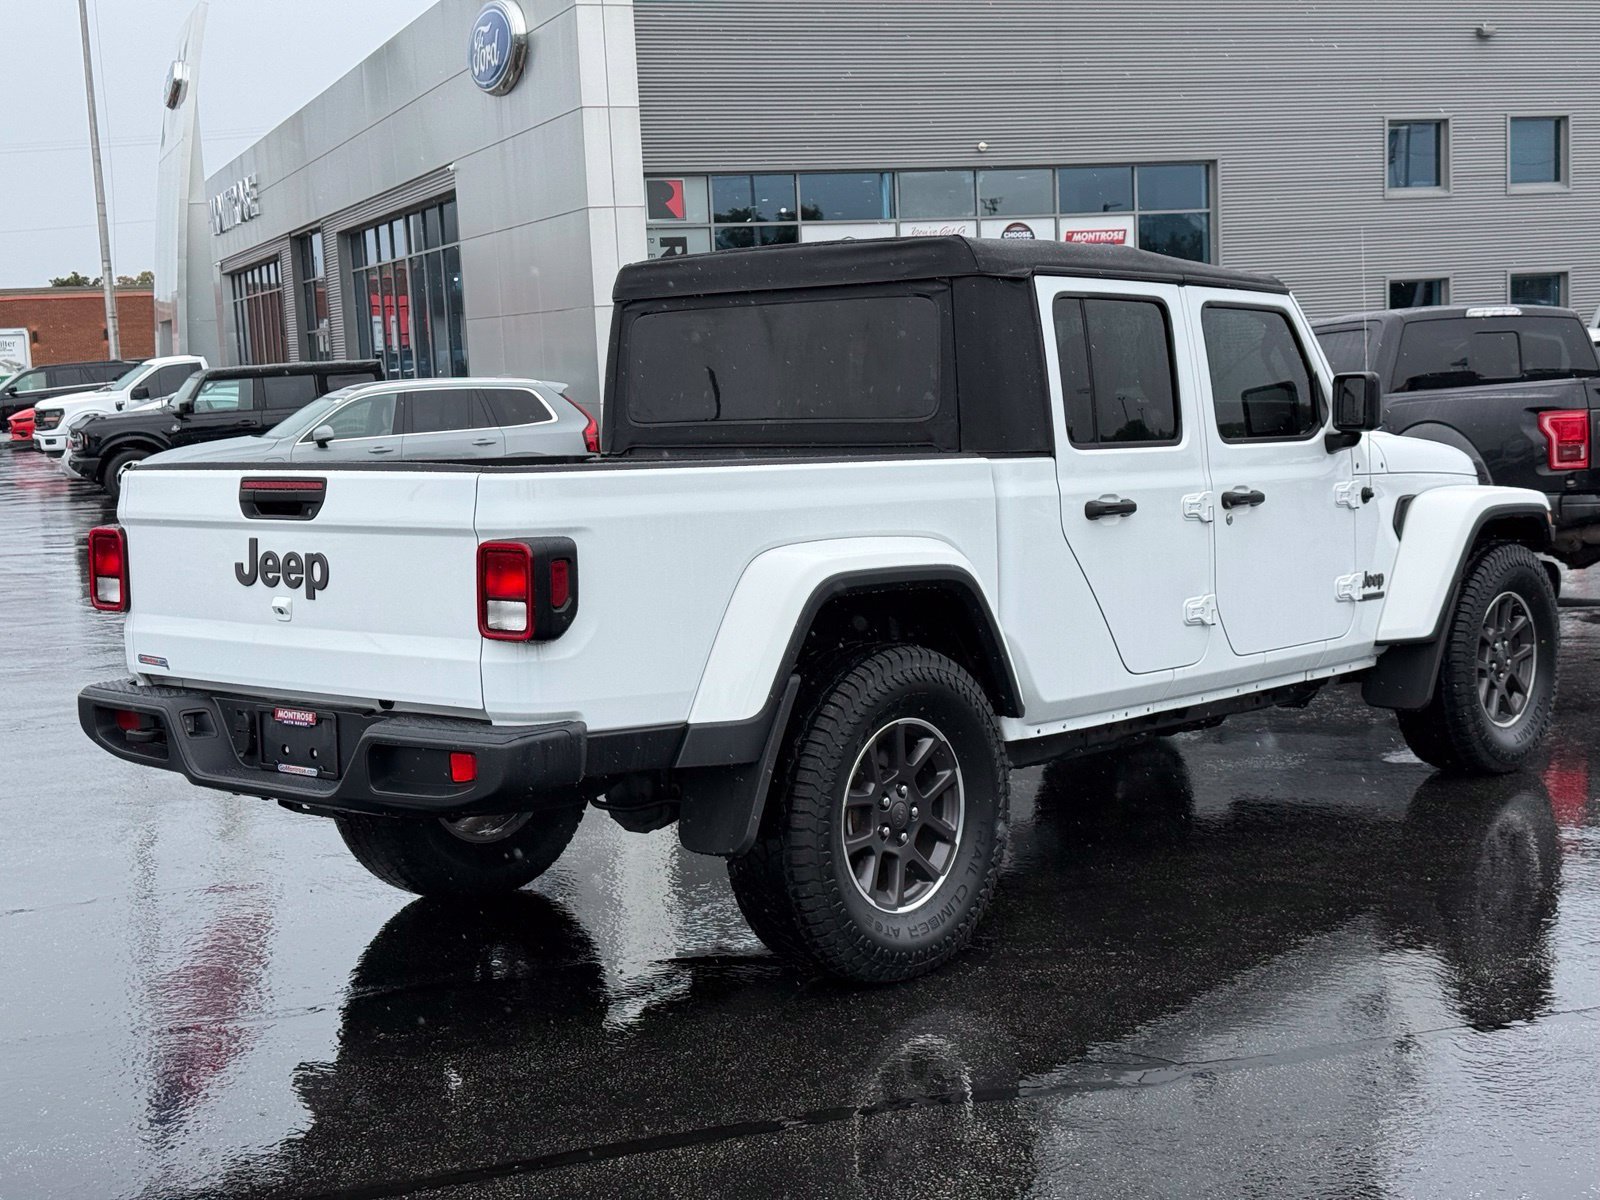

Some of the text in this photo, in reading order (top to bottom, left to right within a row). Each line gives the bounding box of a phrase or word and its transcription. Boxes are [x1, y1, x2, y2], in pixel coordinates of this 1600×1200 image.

[473, 22, 500, 76] Ford
[1071, 230, 1125, 242] MONTROSE
[234, 537, 329, 600] Jeep
[1362, 570, 1384, 590] Jeep
[277, 710, 314, 722] MONTROSE
[907, 883, 969, 940] CLIMBER
